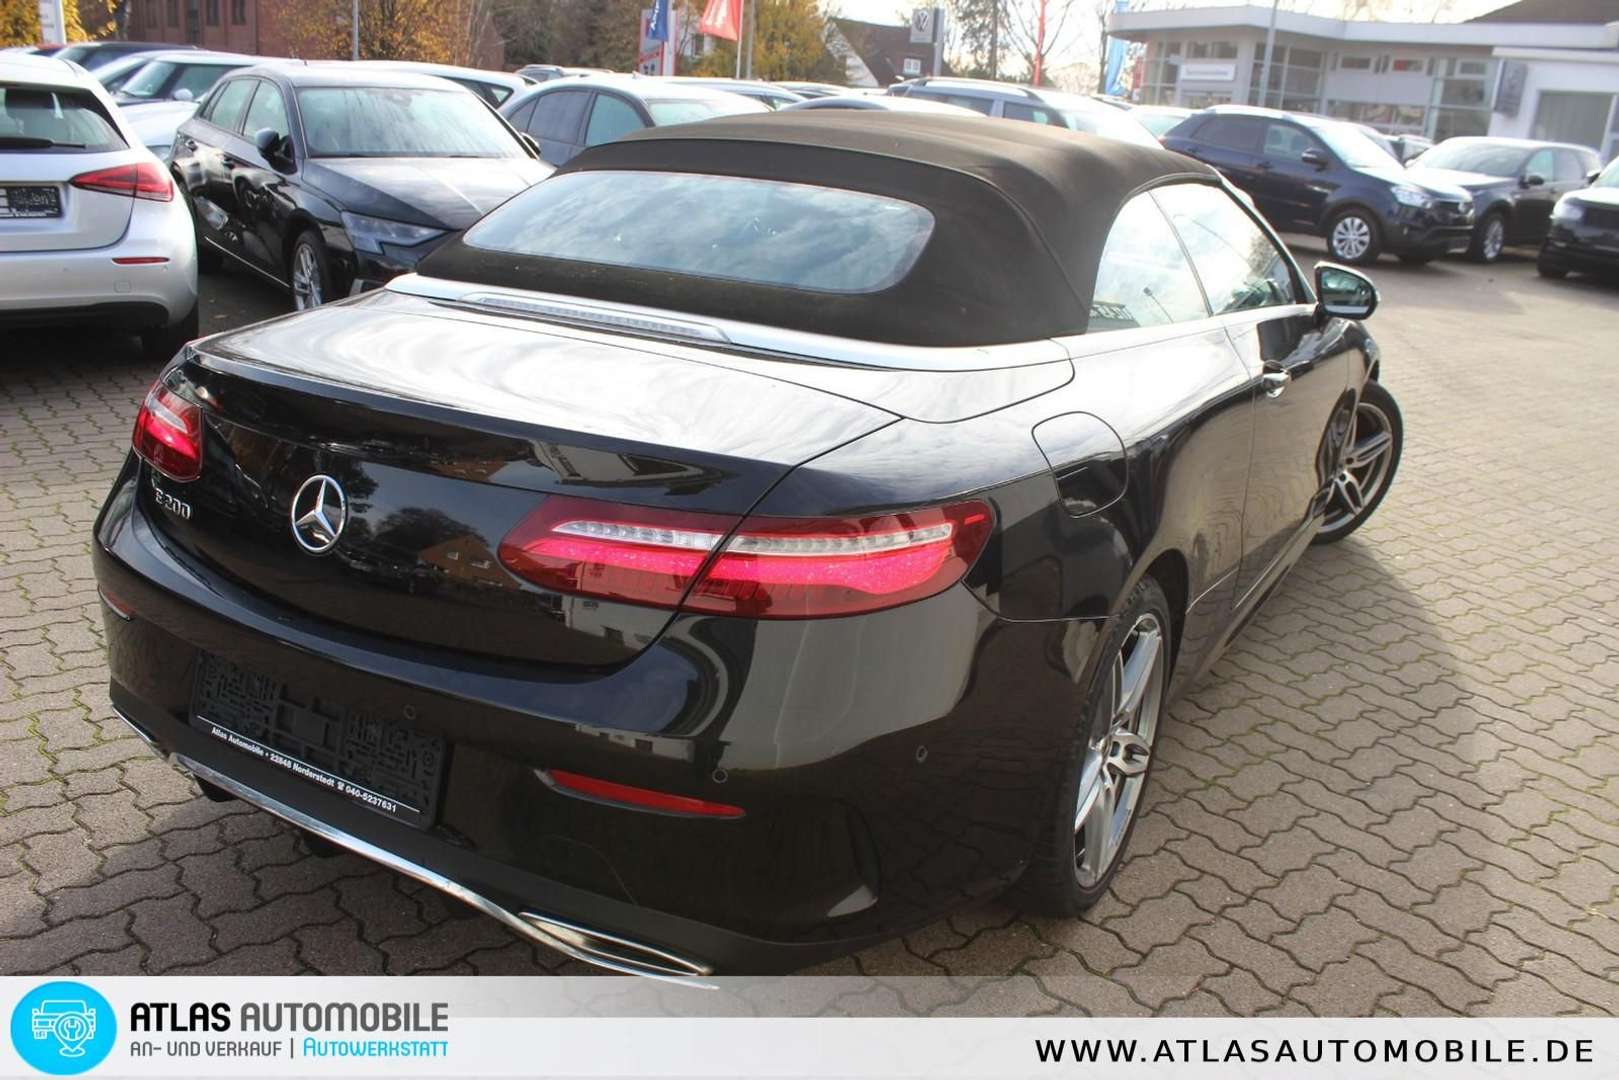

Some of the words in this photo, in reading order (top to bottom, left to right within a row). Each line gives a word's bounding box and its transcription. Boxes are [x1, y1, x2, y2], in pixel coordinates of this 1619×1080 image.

[211, 726, 227, 740] Atlas
[228, 734, 264, 756] Automobile
[293, 763, 335, 787] Norderstedt
[345, 785, 397, 813] 040-5237631
